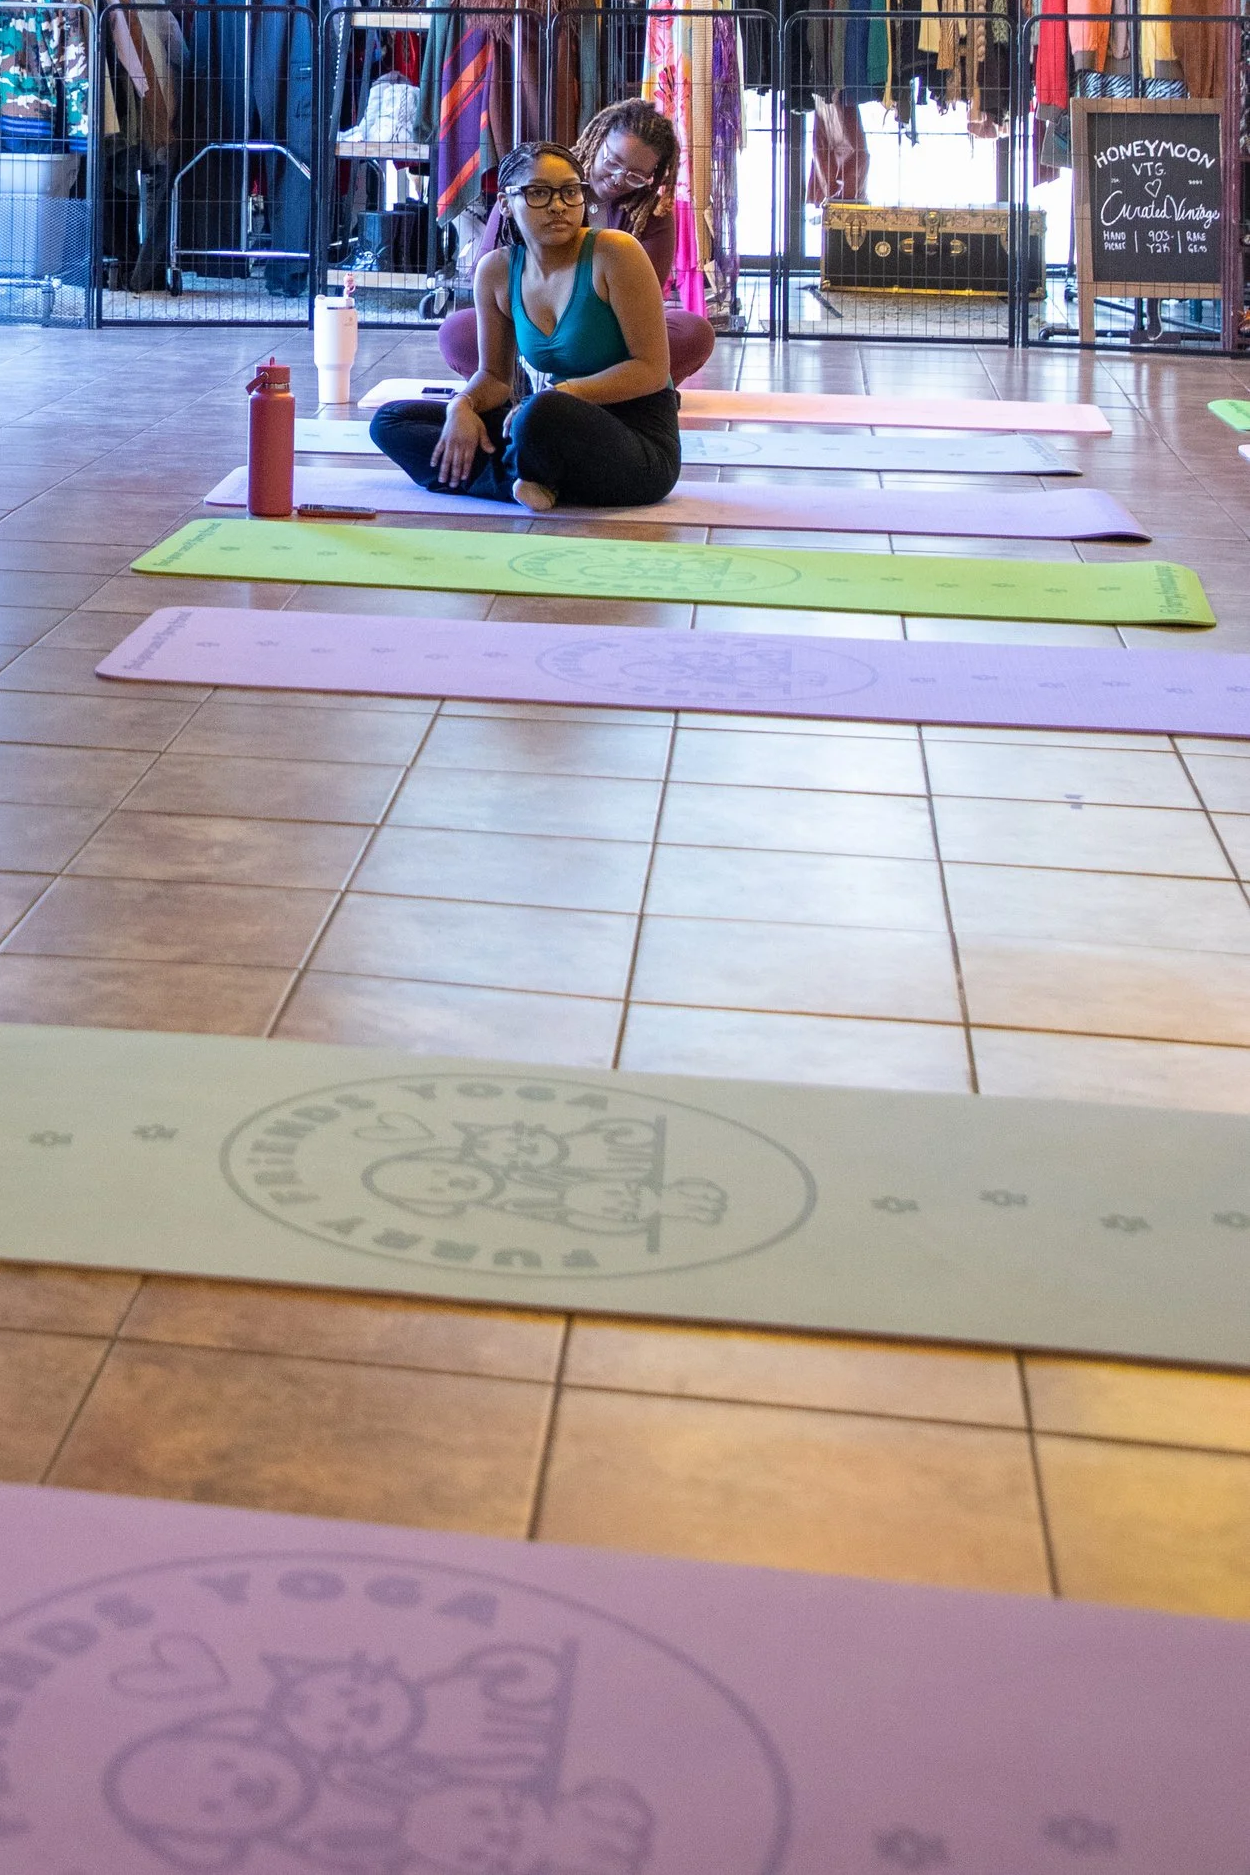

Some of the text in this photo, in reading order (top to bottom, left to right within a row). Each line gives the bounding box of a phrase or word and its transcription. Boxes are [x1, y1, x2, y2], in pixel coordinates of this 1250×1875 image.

[1094, 140, 1216, 169] HONEYMOON
[1132, 162, 1166, 176] VTG.
[1101, 190, 1220, 229] Curated Vintage
[1103, 230, 1126, 241] HAND
[1147, 243, 1170, 253] Y2K
[1186, 231, 1206, 241] RARE
[396, 1081, 609, 1111] YOGA
[315, 1216, 600, 1269] FURRY
[197, 1568, 499, 1627] YOGA
